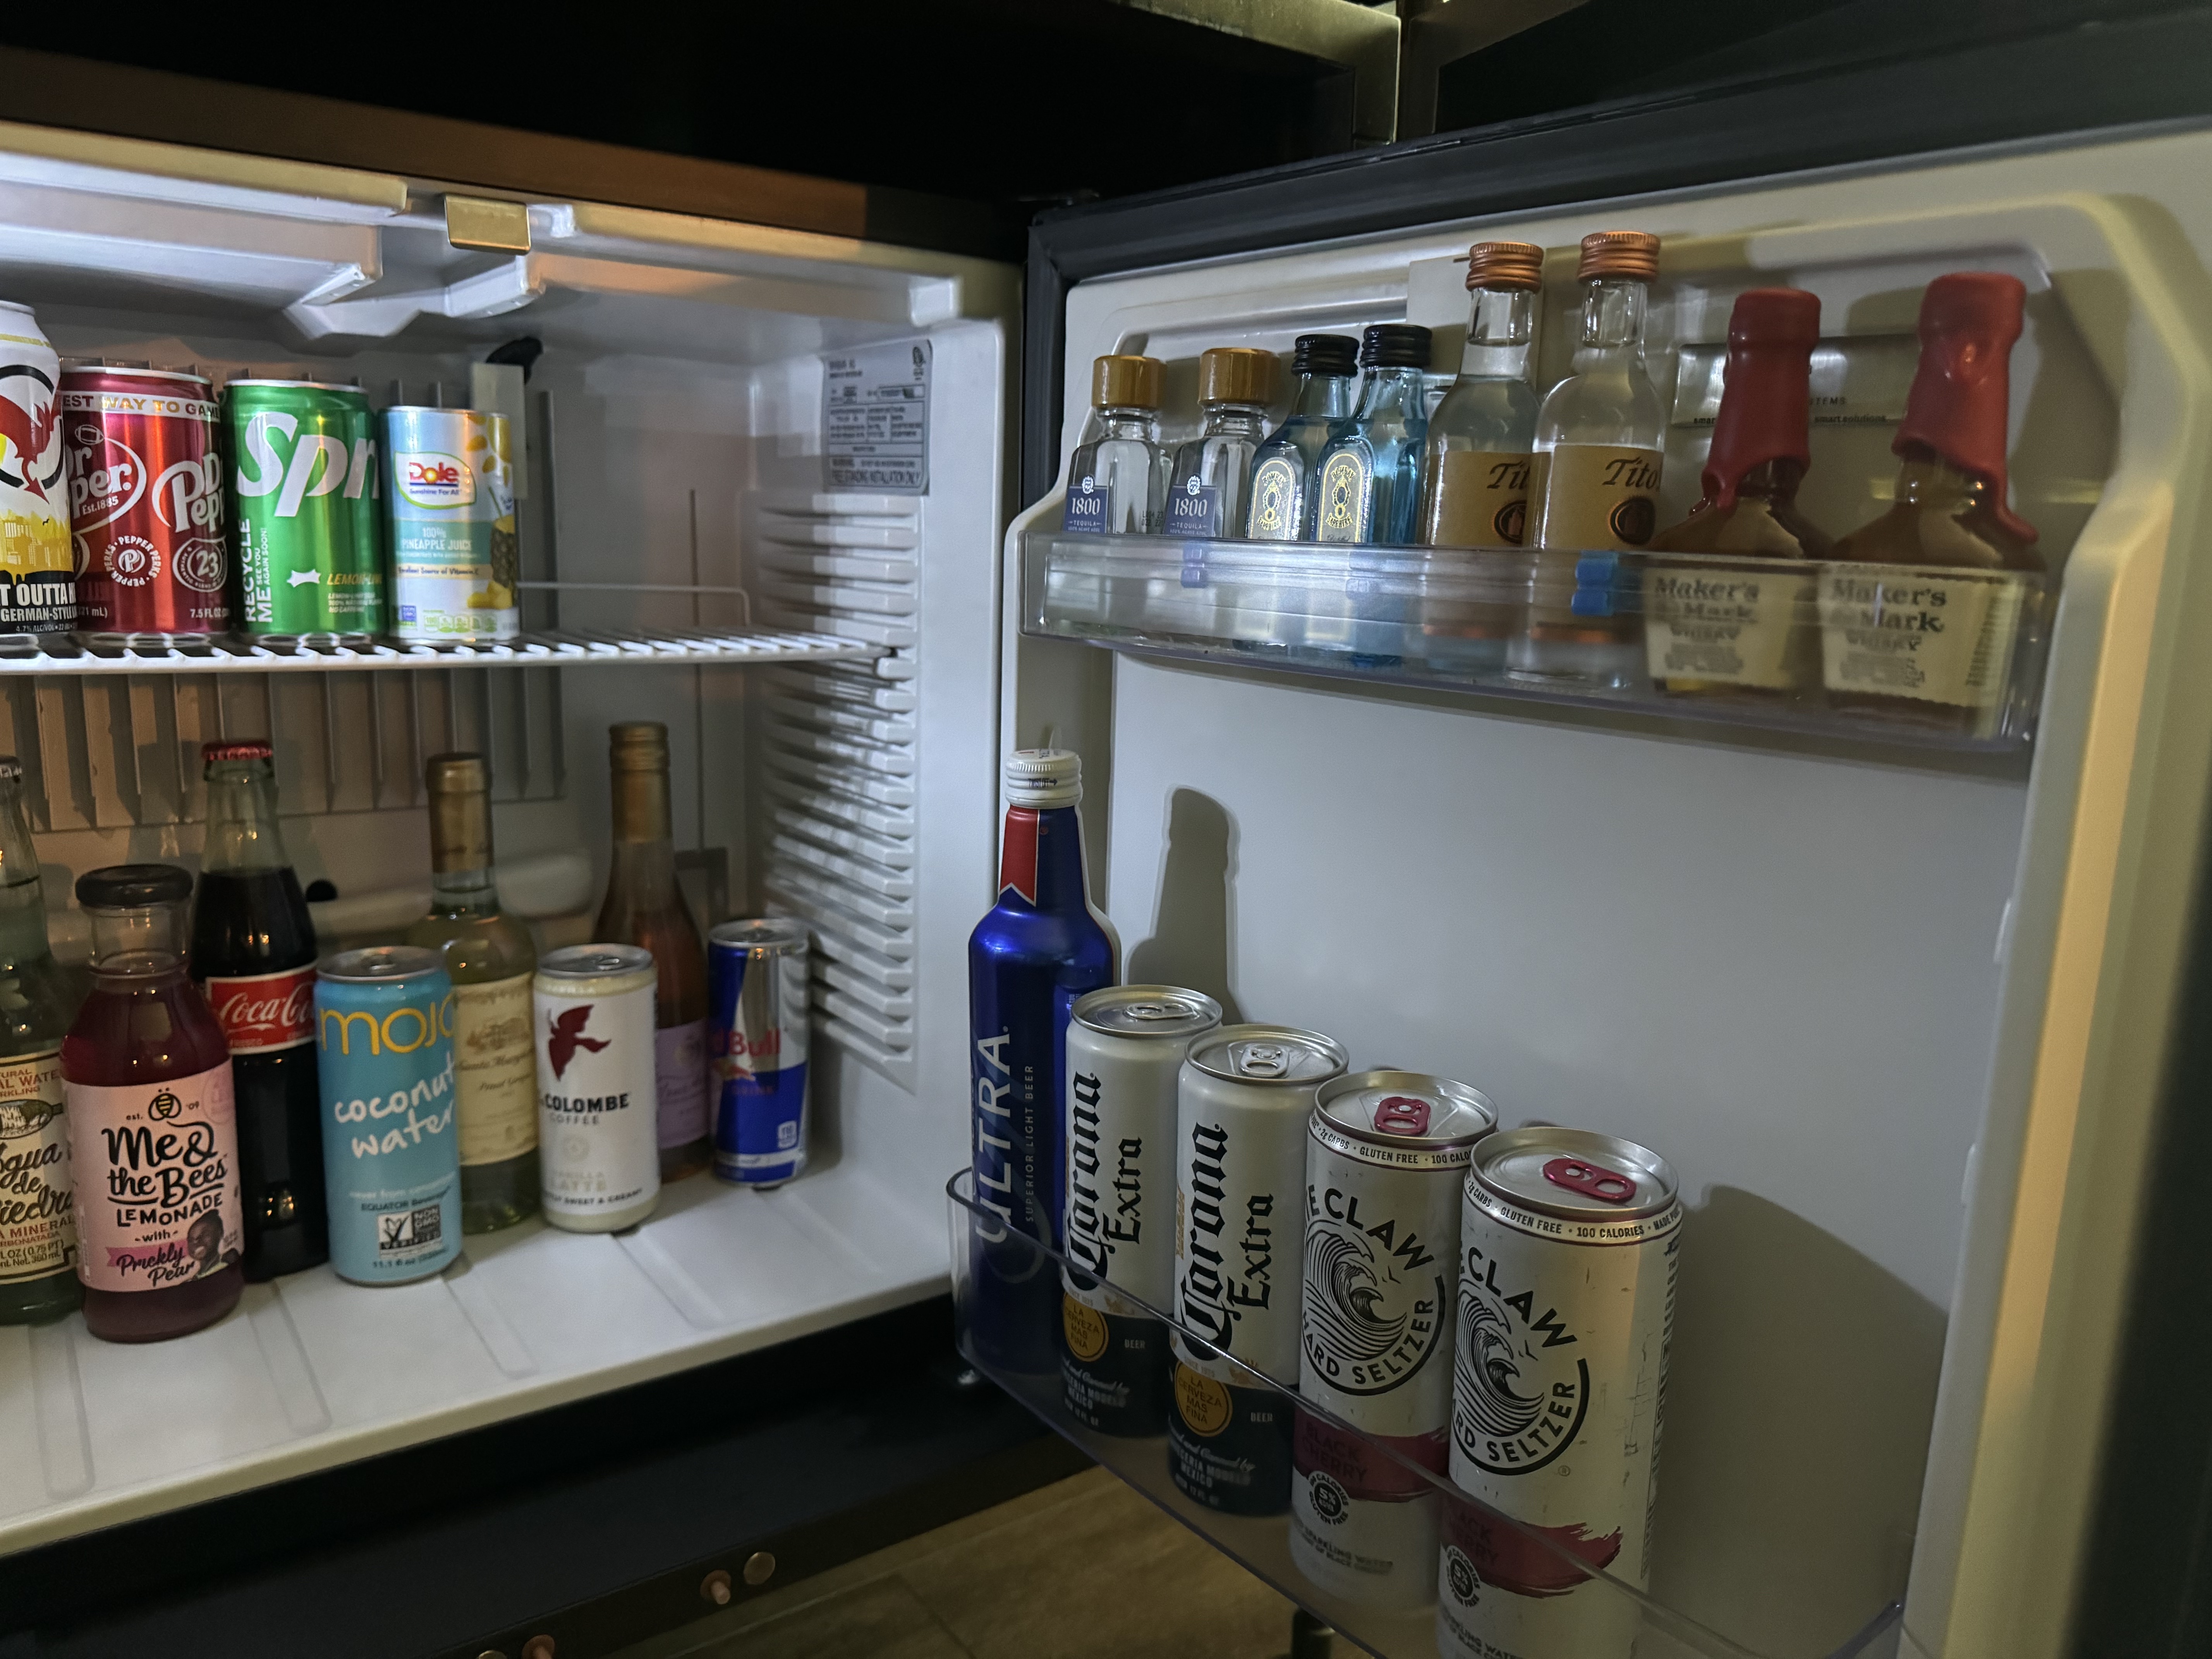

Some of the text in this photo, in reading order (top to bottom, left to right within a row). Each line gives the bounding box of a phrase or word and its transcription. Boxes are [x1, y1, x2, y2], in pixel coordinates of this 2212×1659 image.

[63, 395, 180, 413] EST WAY TO
[409, 462, 459, 484] Dole
[1071, 497, 1100, 516] 1800
[1174, 498, 1208, 517] 1800
[1326, 515, 1353, 528] SAPPHIRE
[401, 538, 472, 551] PINEAPPLE JUICE
[196, 550, 218, 578] 23
[238, 518, 256, 622] RECYCLE
[262, 557, 270, 586] AGAIN
[17, 582, 68, 606] OUTTA
[256, 587, 273, 623] ME
[1833, 578, 1947, 608] Maker's
[190, 608, 204, 619] 7.5
[728, 1027, 781, 1058] Bull
[0, 1069, 32, 1079] URAL
[19, 1068, 61, 1087] WATE
[335, 1051, 455, 1123] coconut
[544, 1091, 630, 1113] COLOMBE
[352, 1098, 455, 1159] water
[549, 1112, 599, 1125] COFFEE
[101, 1121, 218, 1171] Me &
[975, 1031, 1012, 1245] ULTRA
[1025, 1065, 1034, 1223] SUPERIOR LIGHT BEER
[1328, 1133, 1350, 1150] CARBS
[1359, 1146, 1393, 1162] GLUTEN
[1396, 1152, 1418, 1164] FREE
[1431, 1154, 1448, 1164] 100
[0, 1143, 63, 1189] gua
[11, 1171, 43, 1195] de
[107, 1157, 228, 1209] the Bees
[1066, 1070, 1116, 1291] Corona
[1102, 1135, 1142, 1245] Extra
[117, 1192, 223, 1228] LEMONADE
[1474, 1186, 1493, 1208] CARBS
[1500, 1206, 1534, 1228] GLUTEN
[1537, 1219, 1562, 1235] FREE
[1577, 1226, 1596, 1238] 100
[1599, 1224, 1645, 1238] CALORIES
[1653, 1216, 1671, 1231] MADE
[1178, 1120, 1242, 1362] Corona
[1324, 1187, 1434, 1272] CLAW
[116, 1242, 185, 1277] Prickly
[1226, 1193, 1275, 1311] Extra
[147, 1261, 195, 1288] Pear
[1073, 1303, 1084, 1316] LA
[1467, 1246, 1578, 1348] CLAW
[1065, 1309, 1100, 1334] CERVEZA
[1071, 1323, 1088, 1339] MAS
[1070, 1333, 1088, 1350] FINA
[1124, 1339, 1146, 1349] BEER
[1352, 1299, 1434, 1386] SELTZER
[1177, 1375, 1223, 1408] CERVEZA
[1190, 1375, 1204, 1389] LA
[1185, 1406, 1208, 1425] FINA
[1187, 1395, 1208, 1413] MAS
[1250, 1412, 1274, 1422] BEER
[1453, 1381, 1576, 1463] RD SELTZER
[1332, 1512, 1349, 1526] FREE
